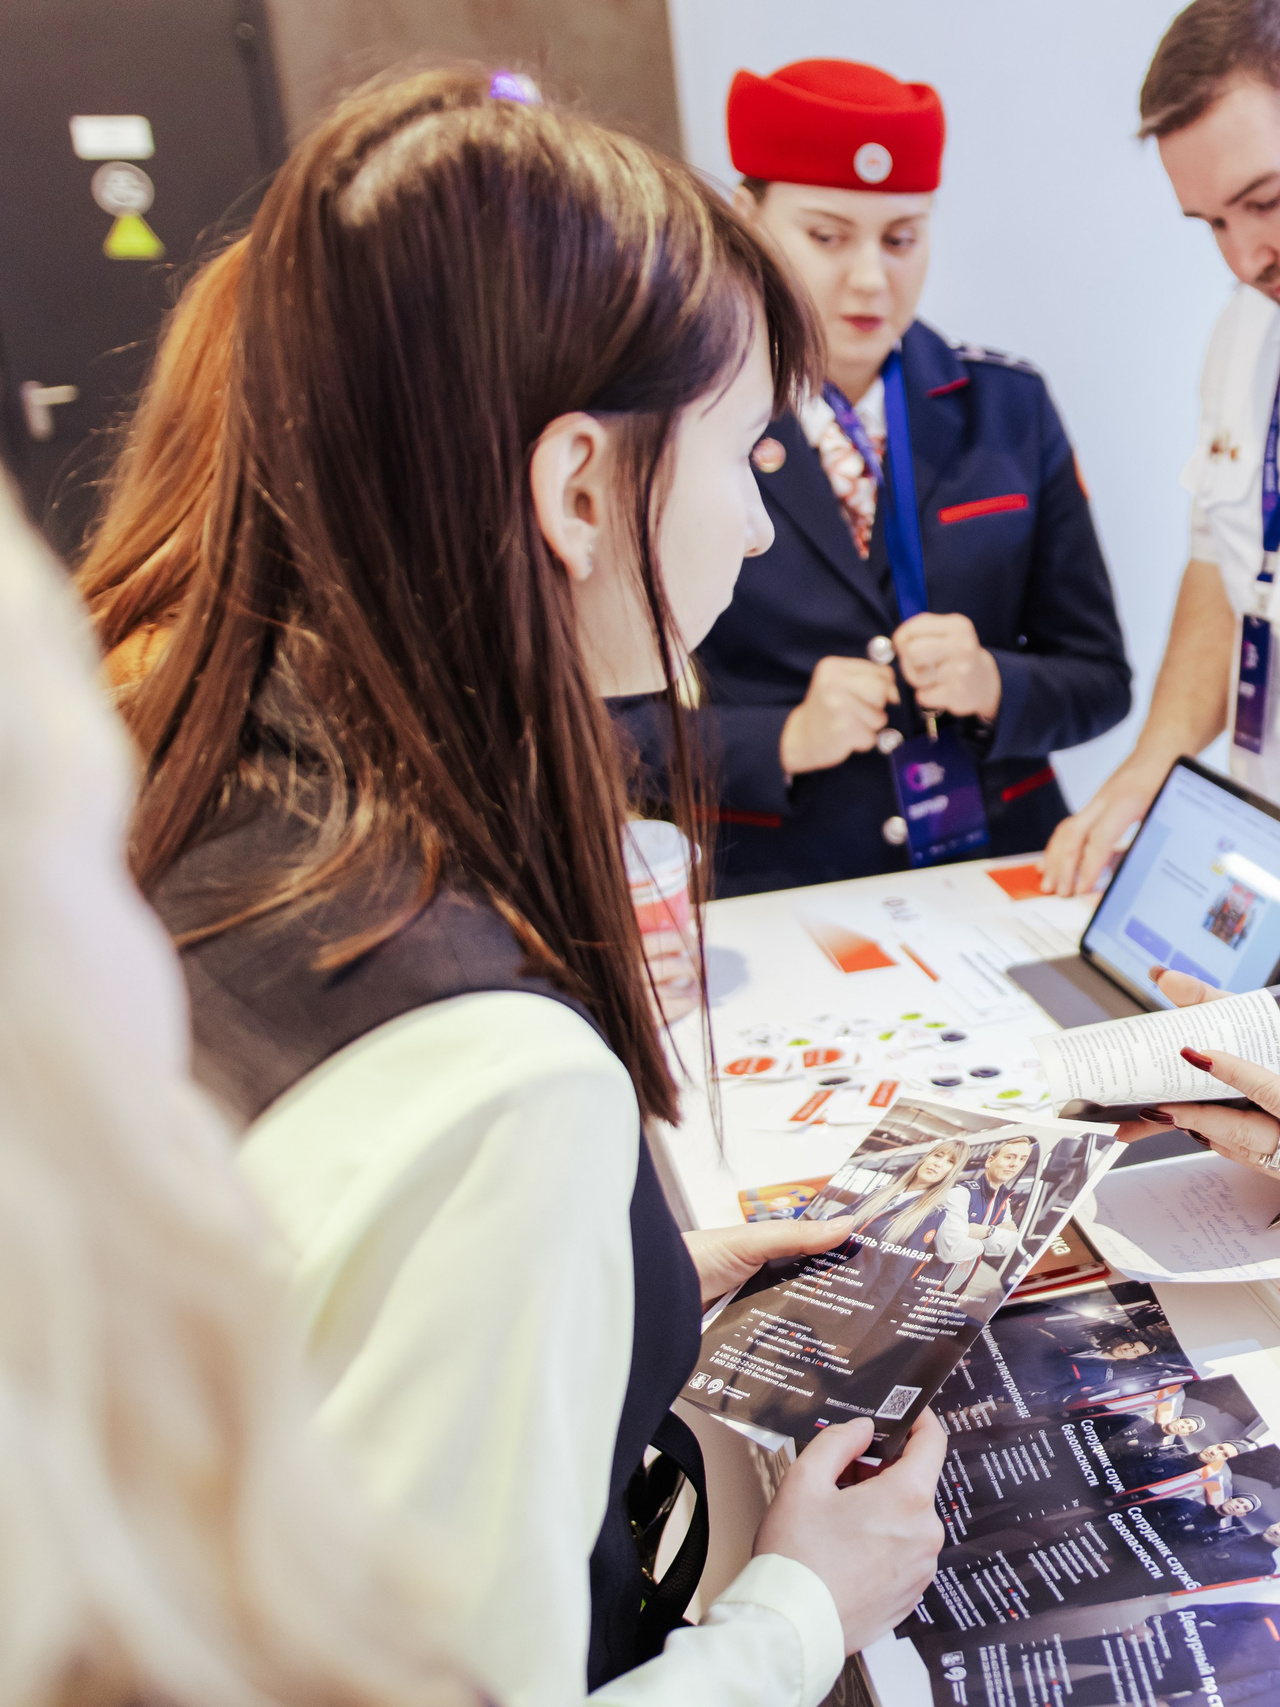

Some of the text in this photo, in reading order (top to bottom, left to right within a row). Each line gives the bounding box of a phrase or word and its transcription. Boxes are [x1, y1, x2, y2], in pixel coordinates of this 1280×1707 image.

[850, 1232, 933, 1262] тель трамвая
[1061, 1423, 1100, 1488] безопасности
[1081, 1419, 1126, 1494] Сотрудник служ
[1108, 1513, 1164, 1580] безопасности
[1127, 1506, 1202, 1591] Сотрудник служб
[1177, 1611, 1215, 1677] Дежурный
[1201, 1676, 1219, 1695] по
